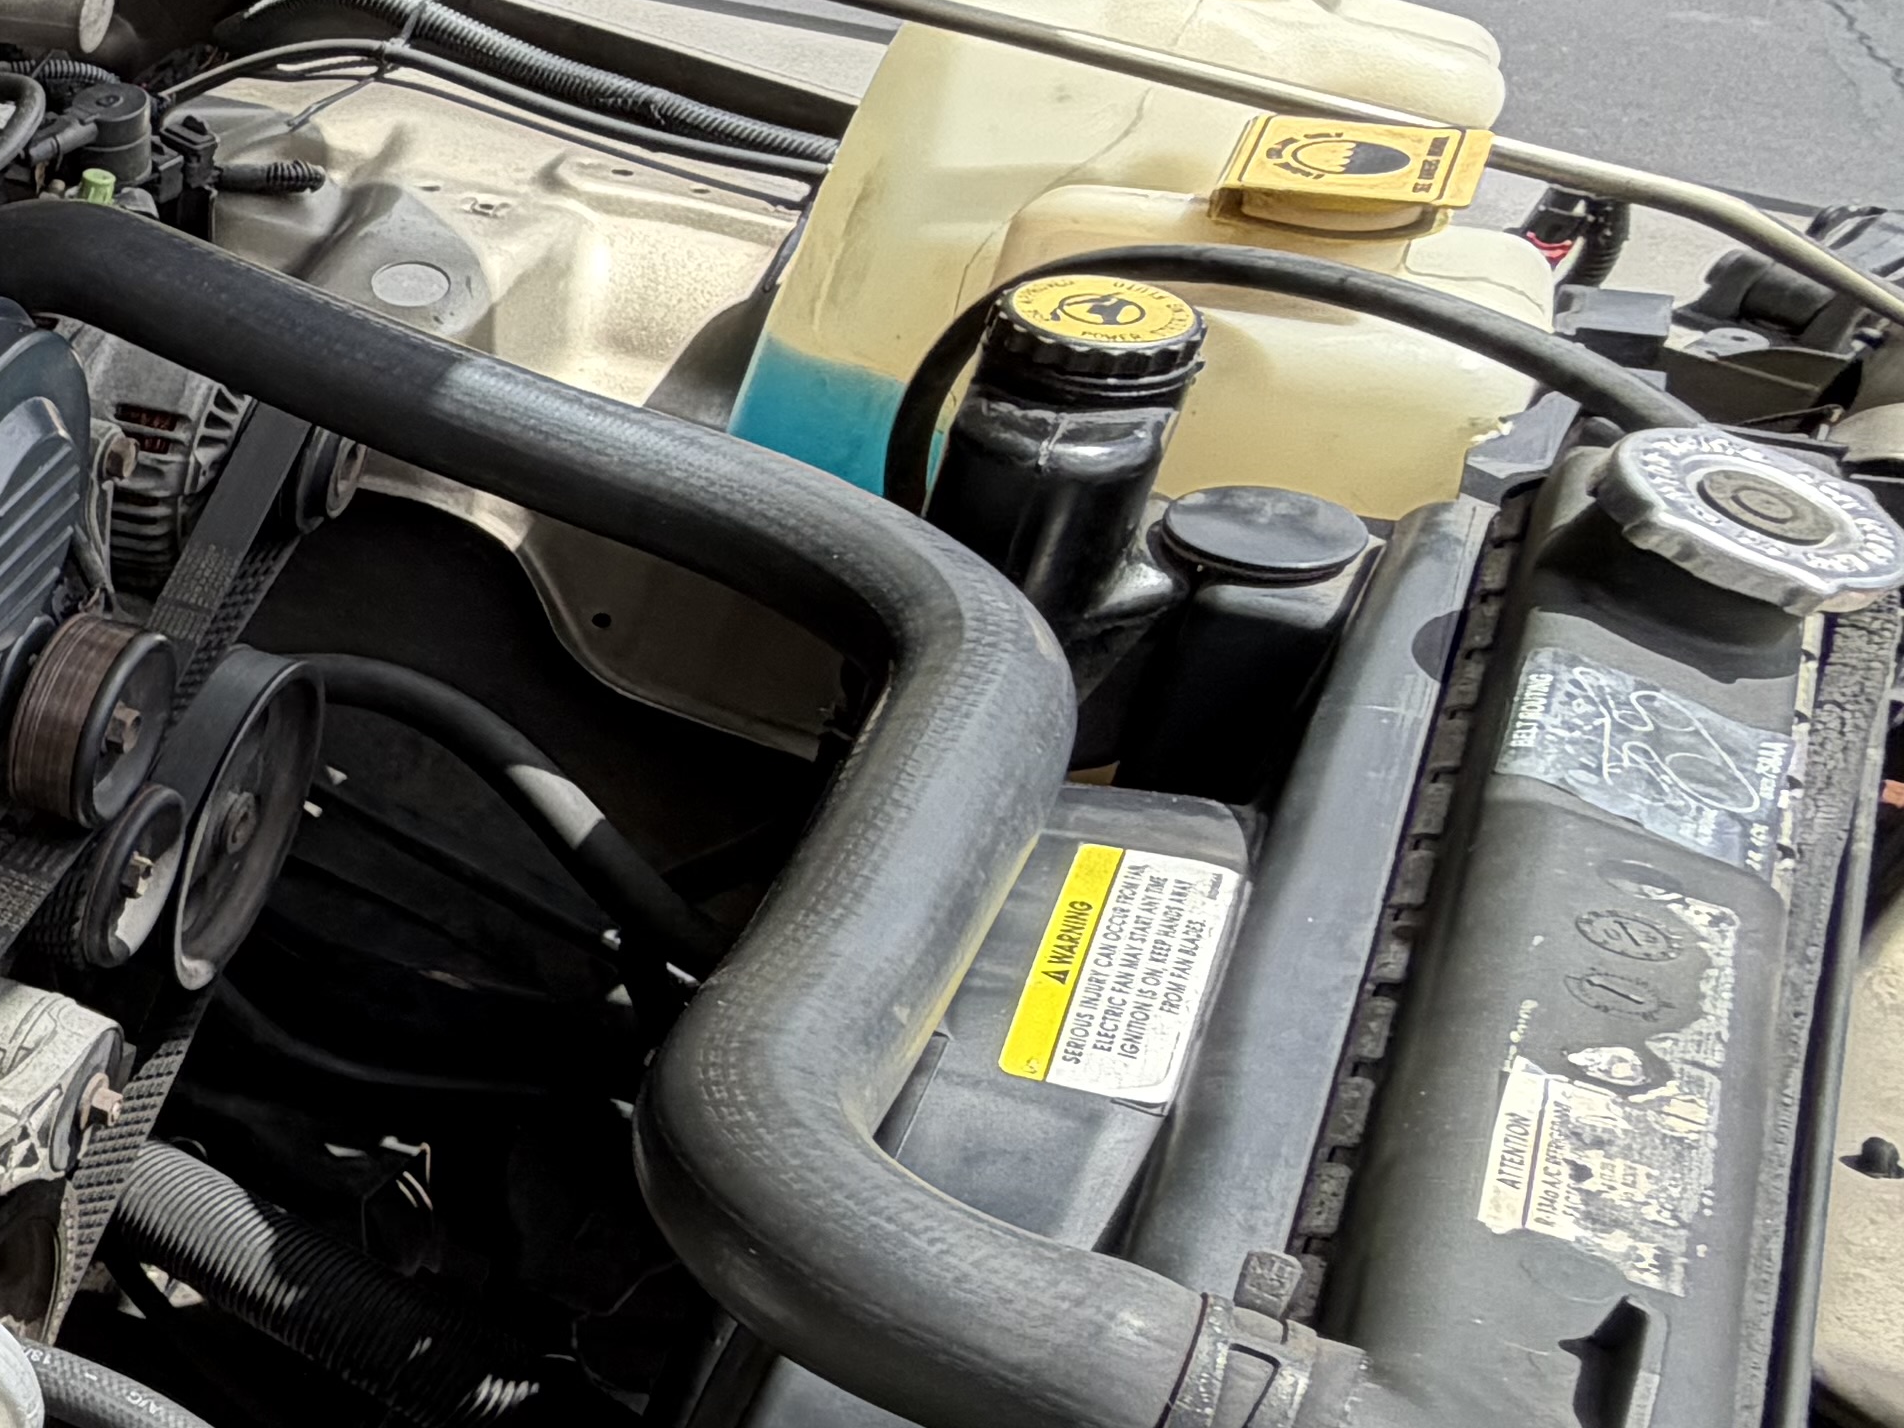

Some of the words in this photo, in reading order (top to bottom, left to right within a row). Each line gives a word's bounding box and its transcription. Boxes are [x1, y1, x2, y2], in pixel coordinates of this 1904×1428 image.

[1081, 330, 1141, 342] POWER
[1516, 668, 1554, 723] ROUTING
[1508, 718, 1540, 749] BELT
[1115, 880, 1140, 905] FROM
[1144, 875, 1168, 895] TIME
[1166, 878, 1193, 904] AWAY
[1137, 894, 1162, 914] ANY
[1046, 898, 1094, 968] WARNING
[1102, 905, 1131, 942] OCCUR
[1127, 914, 1154, 943] START
[1156, 904, 1184, 938] HANDS
[1093, 941, 1119, 969] CAN
[1119, 943, 1145, 970] MAY
[1147, 938, 1174, 965] KEEP
[1169, 956, 1194, 980] FAN
[1078, 968, 1110, 1010] INJURY
[1110, 970, 1136, 995] FAN
[1135, 987, 1158, 1000] IS
[1158, 980, 1187, 1014] FROM
[1059, 1010, 1096, 1064] SERIOUS
[1090, 995, 1128, 1053] ELECTRIC
[1115, 1000, 1154, 1060] IGNITION
[1495, 1110, 1531, 1190] ATTENTION
[1540, 1164, 1564, 1190] A/C
